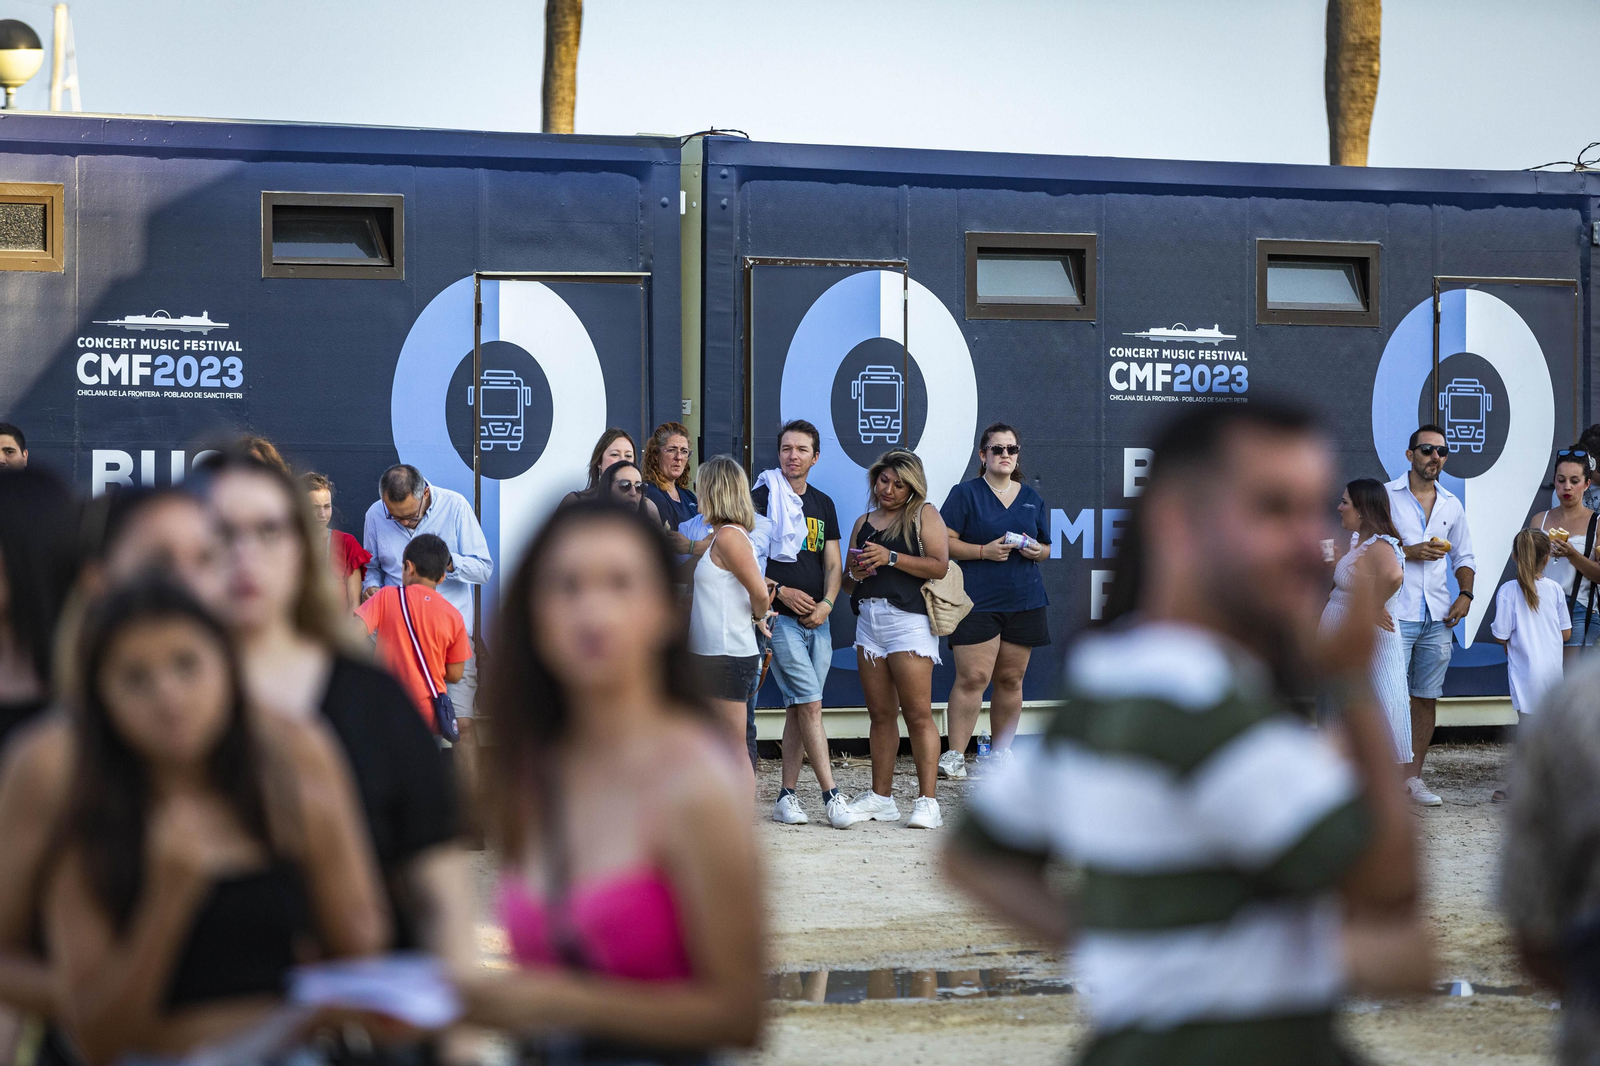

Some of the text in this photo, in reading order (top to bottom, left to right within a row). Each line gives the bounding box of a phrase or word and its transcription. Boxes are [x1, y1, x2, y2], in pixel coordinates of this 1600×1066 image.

[77, 337, 243, 352] CONCERT MUSIC FESTIVAL
[1109, 347, 1248, 361] CONCERT MUSIC FESTIVAL
[76, 352, 244, 388] CMF2023
[1108, 361, 1249, 394] CMF2023
[77, 389, 108, 397] CHICLANA
[128, 390, 161, 398] FRONTERA
[163, 391, 194, 399] POBLADO
[194, 391, 203, 399] DE
[203, 391, 225, 399] SANCTI
[225, 392, 243, 400] PETRI
